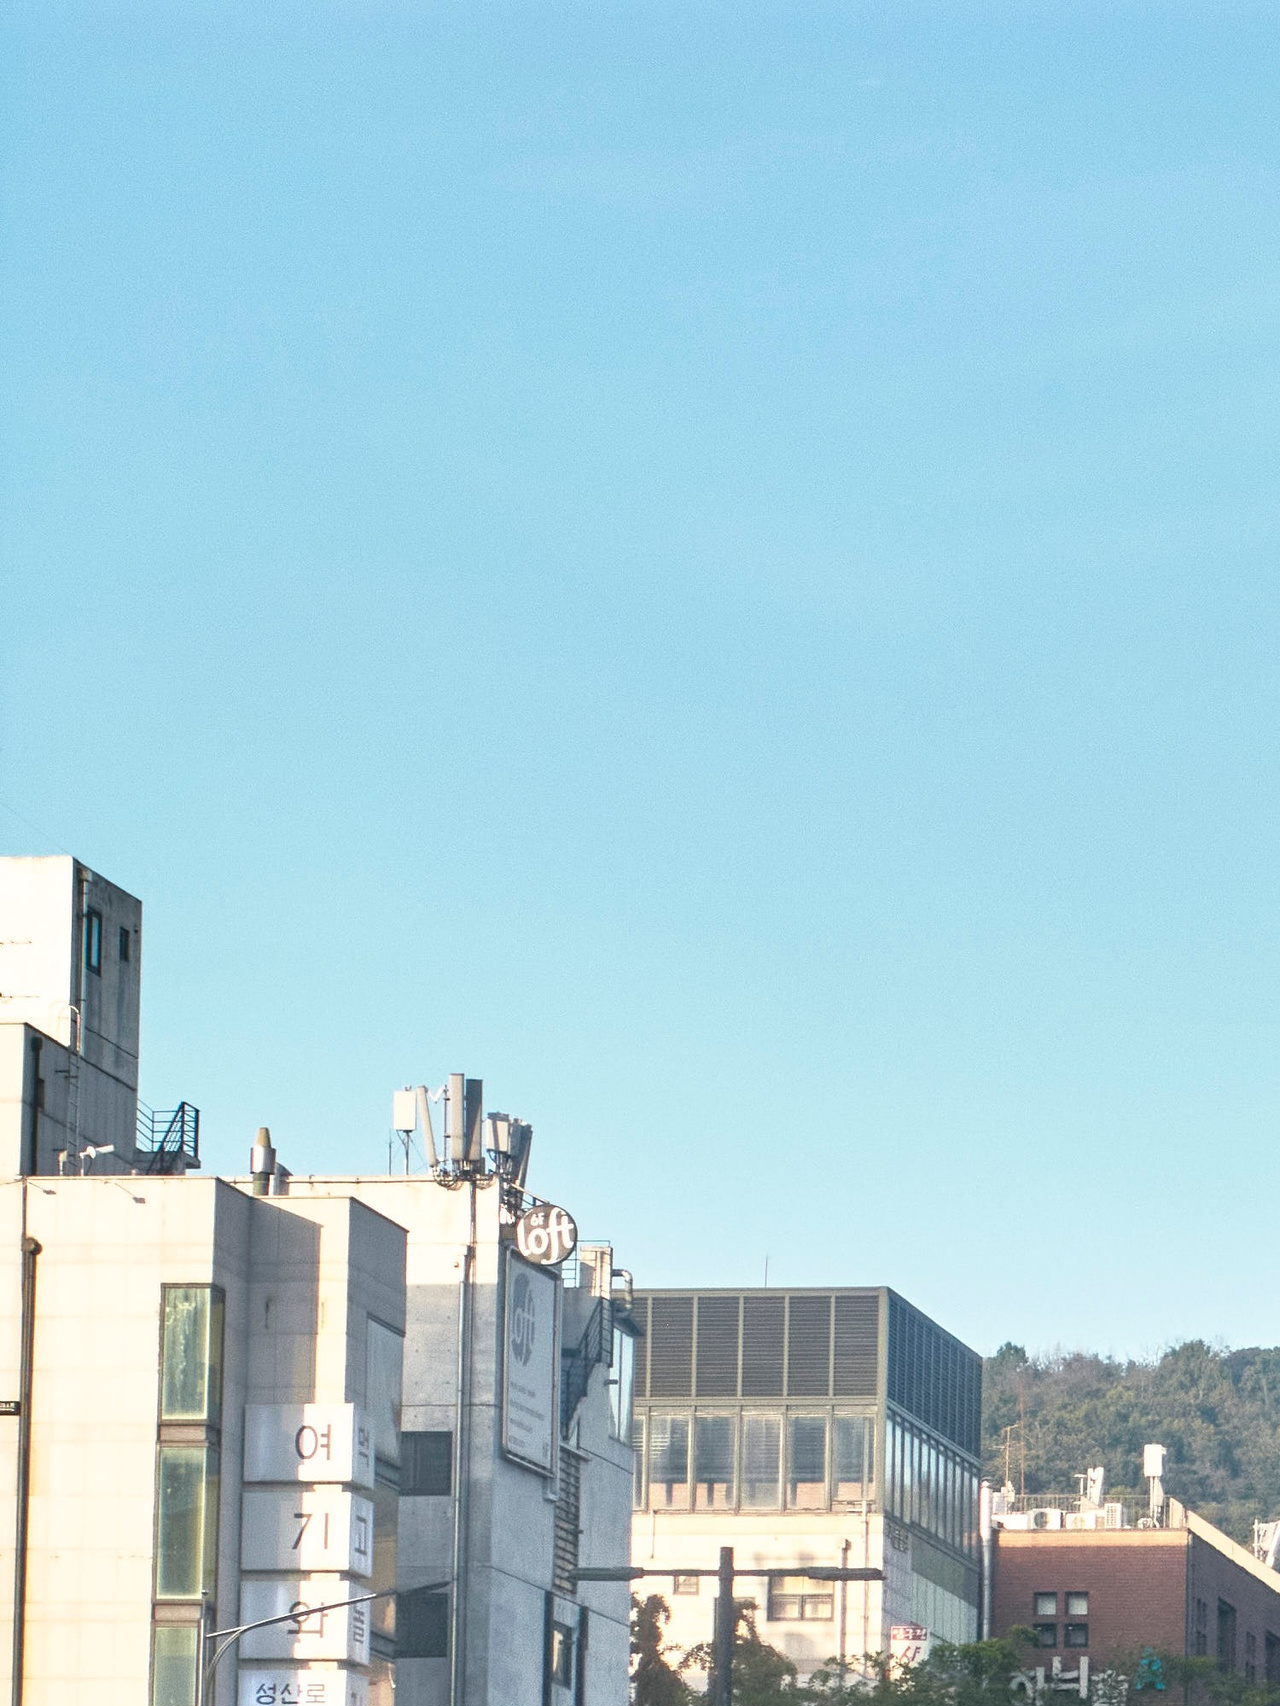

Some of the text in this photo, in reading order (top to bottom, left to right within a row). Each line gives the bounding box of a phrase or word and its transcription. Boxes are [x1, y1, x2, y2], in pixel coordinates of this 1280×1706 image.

[530, 1212, 545, 1226] 6F
[517, 1207, 575, 1265] loft
[256, 1683, 326, 1705] 성산로
